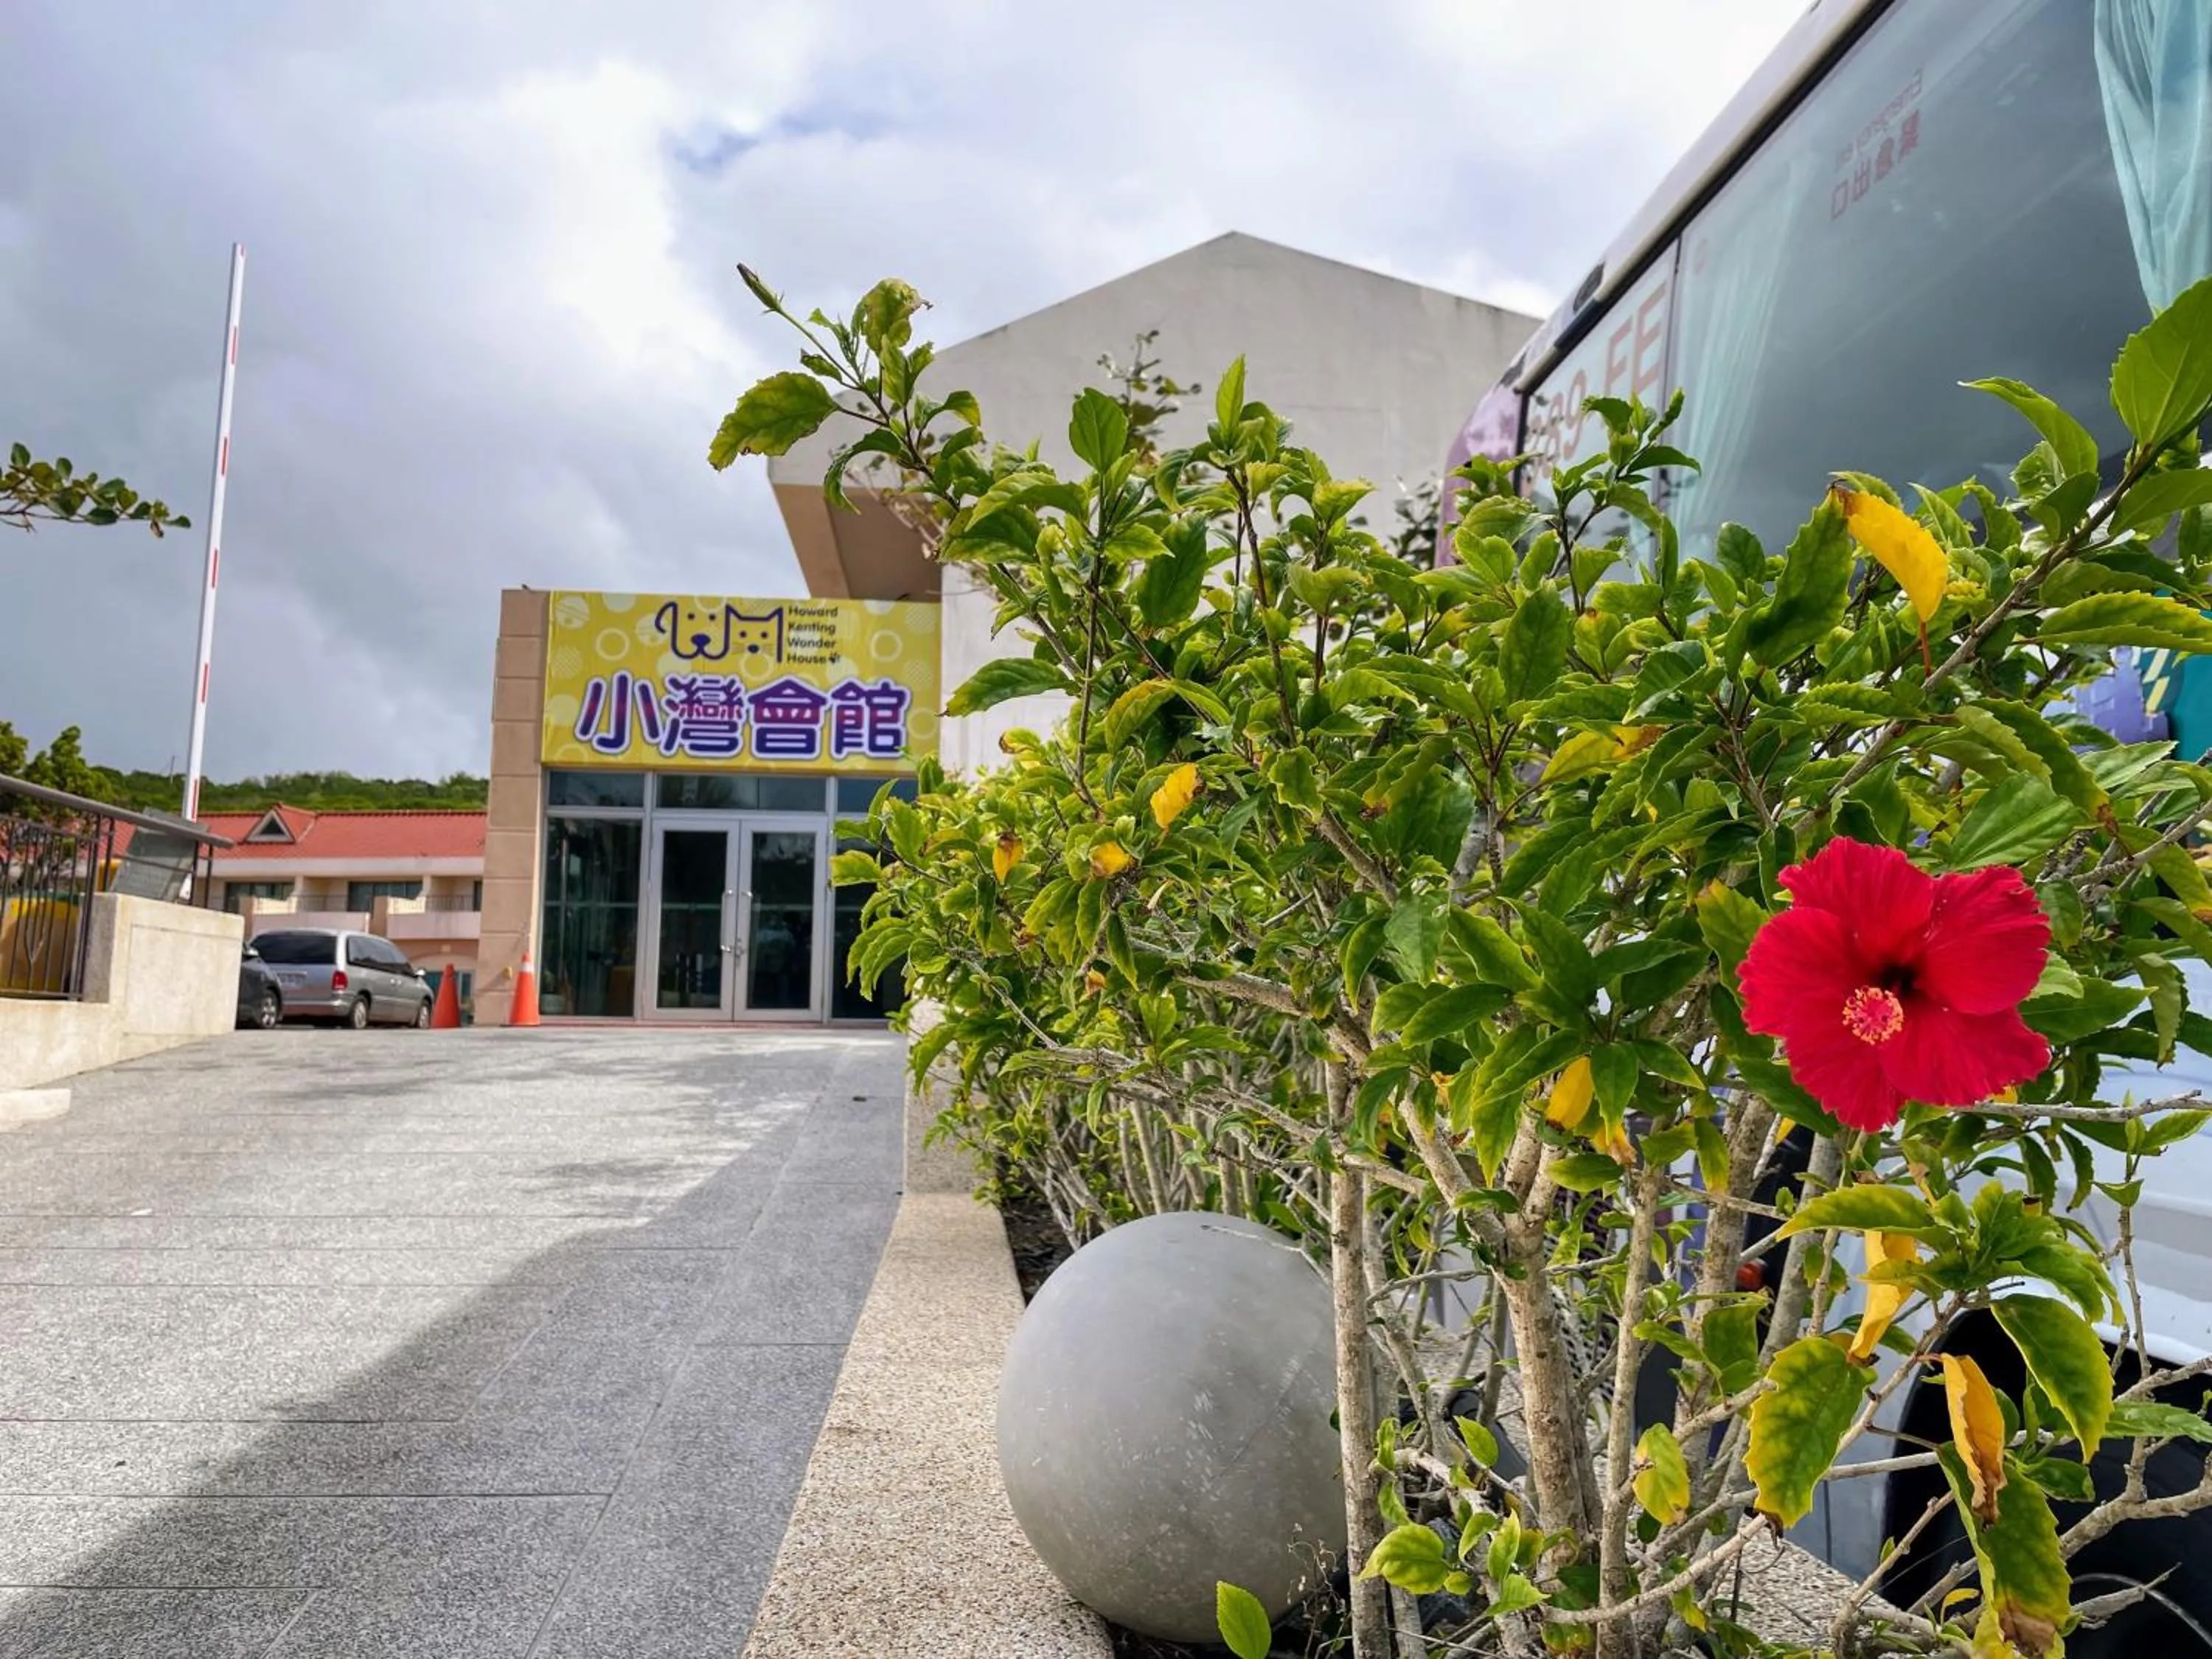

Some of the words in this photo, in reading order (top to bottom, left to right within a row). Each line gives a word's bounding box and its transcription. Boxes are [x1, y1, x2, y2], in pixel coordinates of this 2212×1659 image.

[787, 605, 838, 618] Howard
[787, 622, 836, 636] Kenting
[787, 637, 837, 649] Wonder
[786, 653, 827, 664] House
[576, 671, 912, 759] 小灣會館
